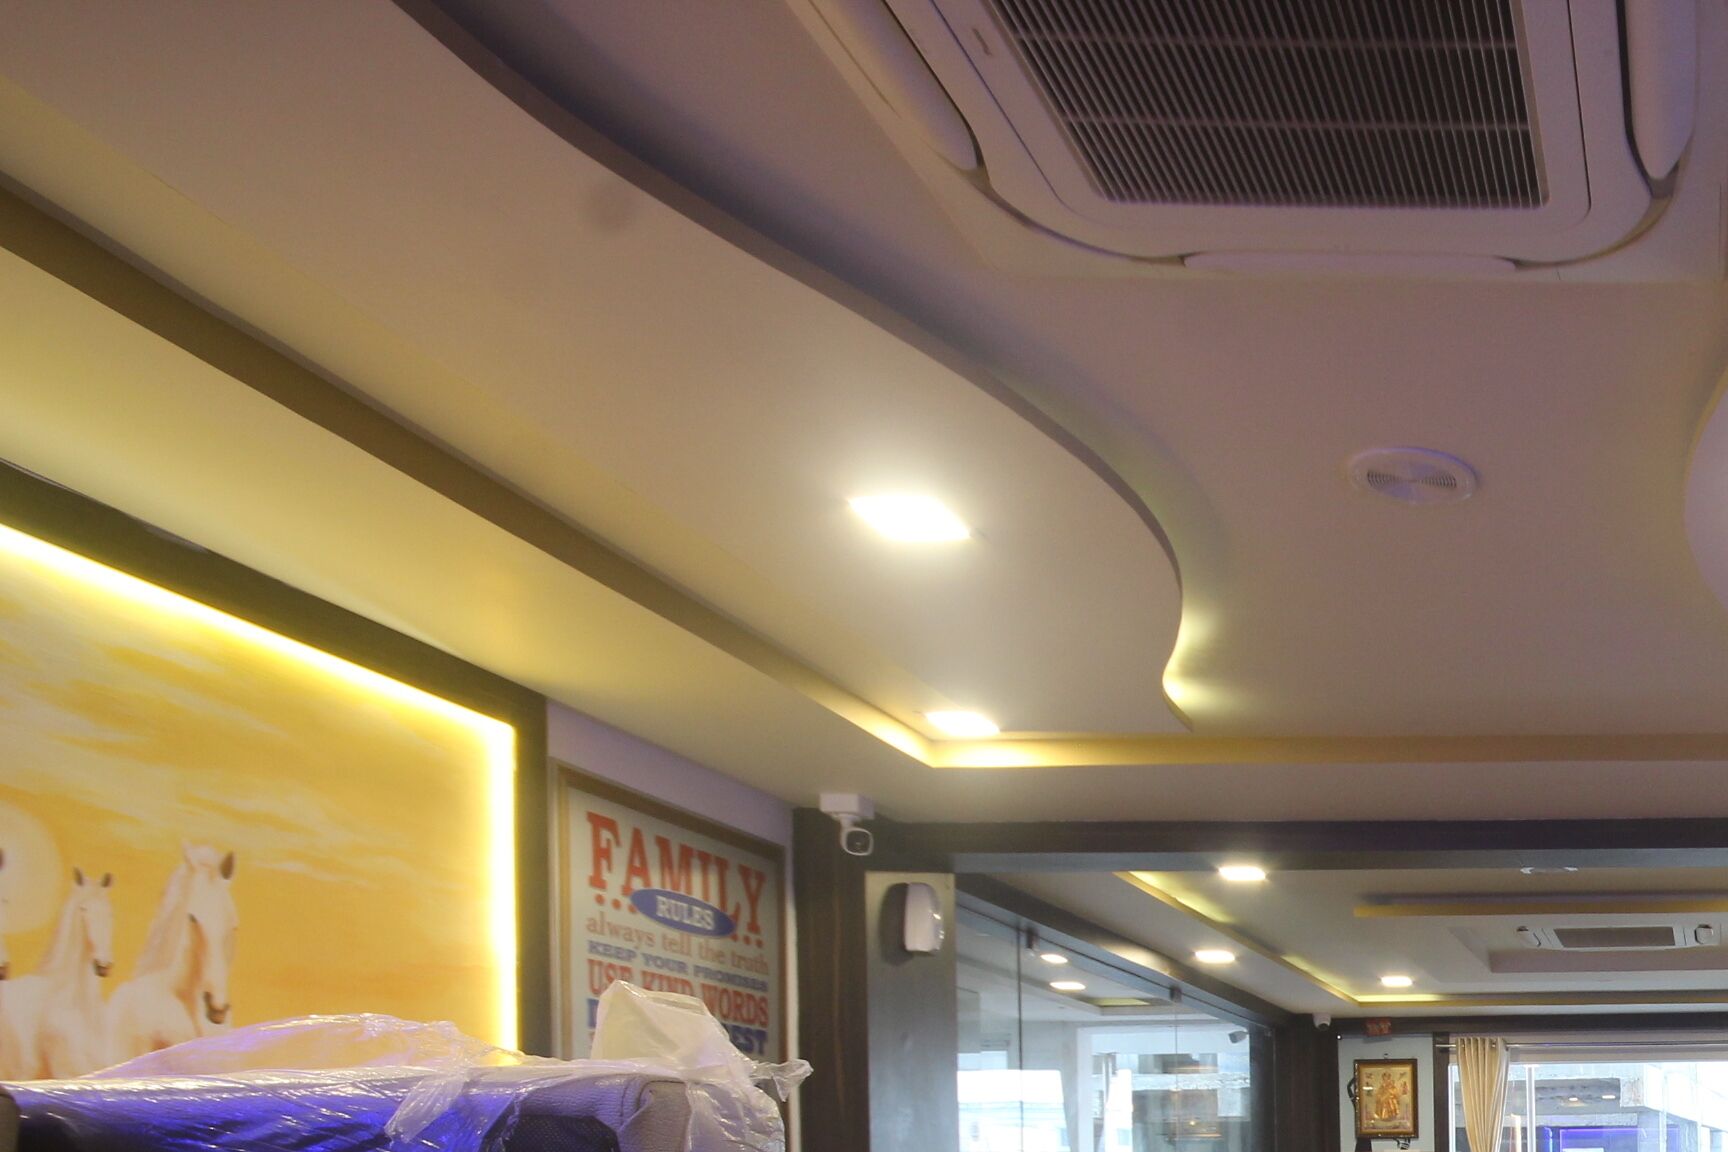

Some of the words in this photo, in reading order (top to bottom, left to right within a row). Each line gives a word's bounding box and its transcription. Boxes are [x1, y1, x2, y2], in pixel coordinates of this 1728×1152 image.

[587, 812, 766, 934] FAMILY
[587, 911, 655, 949] always
[663, 931, 691, 956] tell
[657, 897, 715, 930] RULES
[588, 941, 636, 961] KEEP
[641, 952, 688, 976] YOUR
[701, 982, 769, 1028] WORDS
